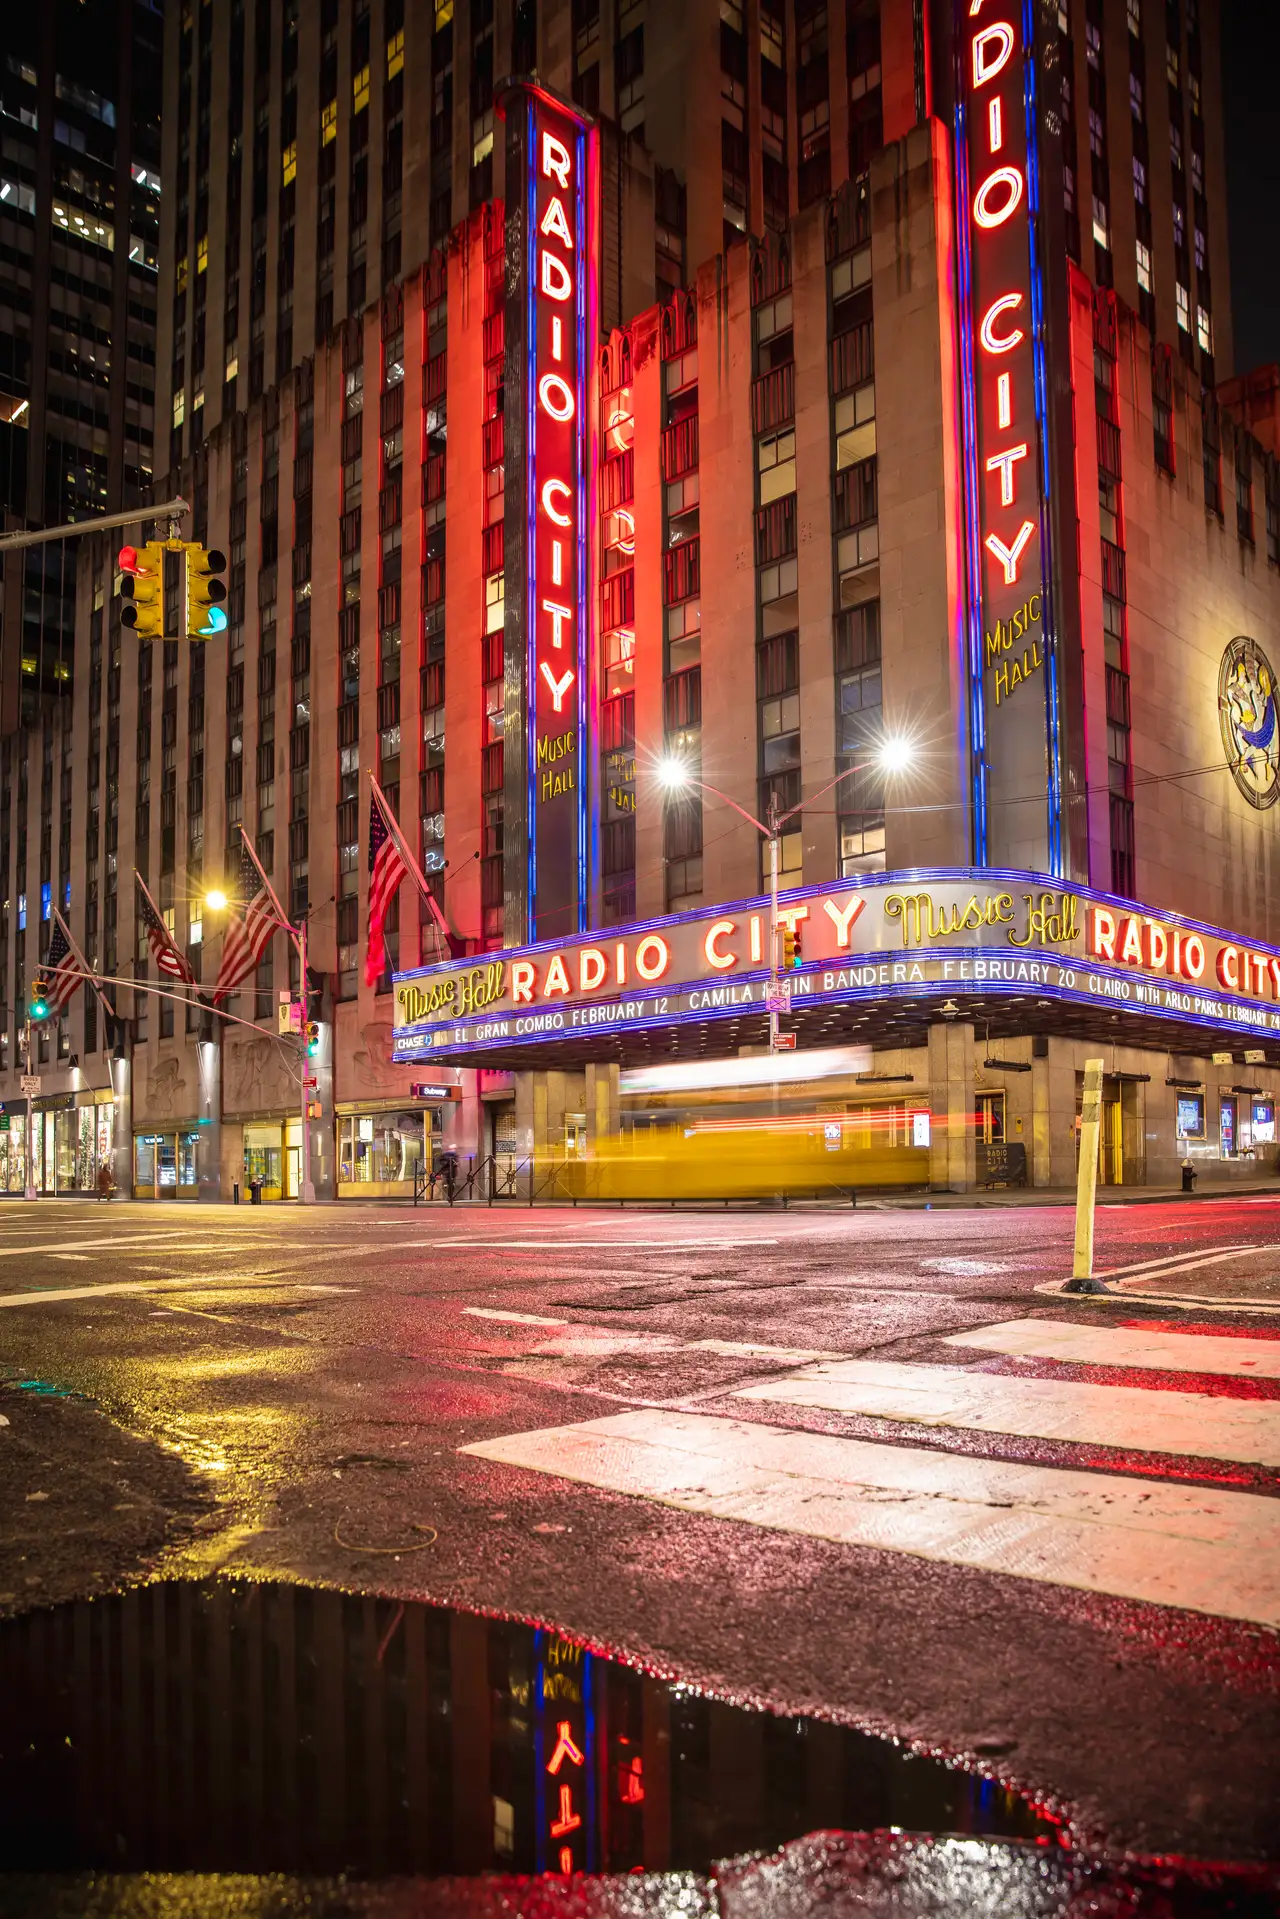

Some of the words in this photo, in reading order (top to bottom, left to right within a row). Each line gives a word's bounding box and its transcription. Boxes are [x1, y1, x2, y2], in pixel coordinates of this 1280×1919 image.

[969, 0, 1023, 229] DIO
[539, 131, 574, 422] RADIO
[980, 293, 1034, 584] CITY
[540, 479, 574, 711] CITY
[986, 595, 1040, 666] MUSIC
[995, 643, 1042, 705] HALL
[537, 731, 575, 768] MUSIC
[542, 768, 575, 802] HALL
[512, 935, 668, 1002] RADIO
[705, 894, 865, 969] CITY
[885, 893, 1015, 945] Music
[1008, 893, 1080, 947] Hall
[1086, 908, 1206, 980] RADIO
[398, 980, 455, 1023] Music
[451, 961, 505, 1017] Hall
[690, 985, 753, 1009] CAMILA
[824, 963, 924, 990] BANDERA
[944, 960, 1049, 983] FEBRUARY
[1058, 969, 1075, 988] 20
[1089, 976, 1130, 999] CLAIRO
[1136, 985, 1160, 1004] WITH
[1165, 991, 1190, 1010] ARLO
[1195, 998, 1223, 1017] PARKS
[1227, 1004, 1267, 1026] FEBRUARY
[398, 1036, 424, 1049] CHASE
[455, 1030, 468, 1043] EL
[477, 1023, 508, 1039] GRAN
[516, 1013, 563, 1033] COMBO
[573, 1003, 645, 1026] FEBRUARY
[655, 998, 668, 1014] 12
[424, 1087, 447, 1097] Subway
